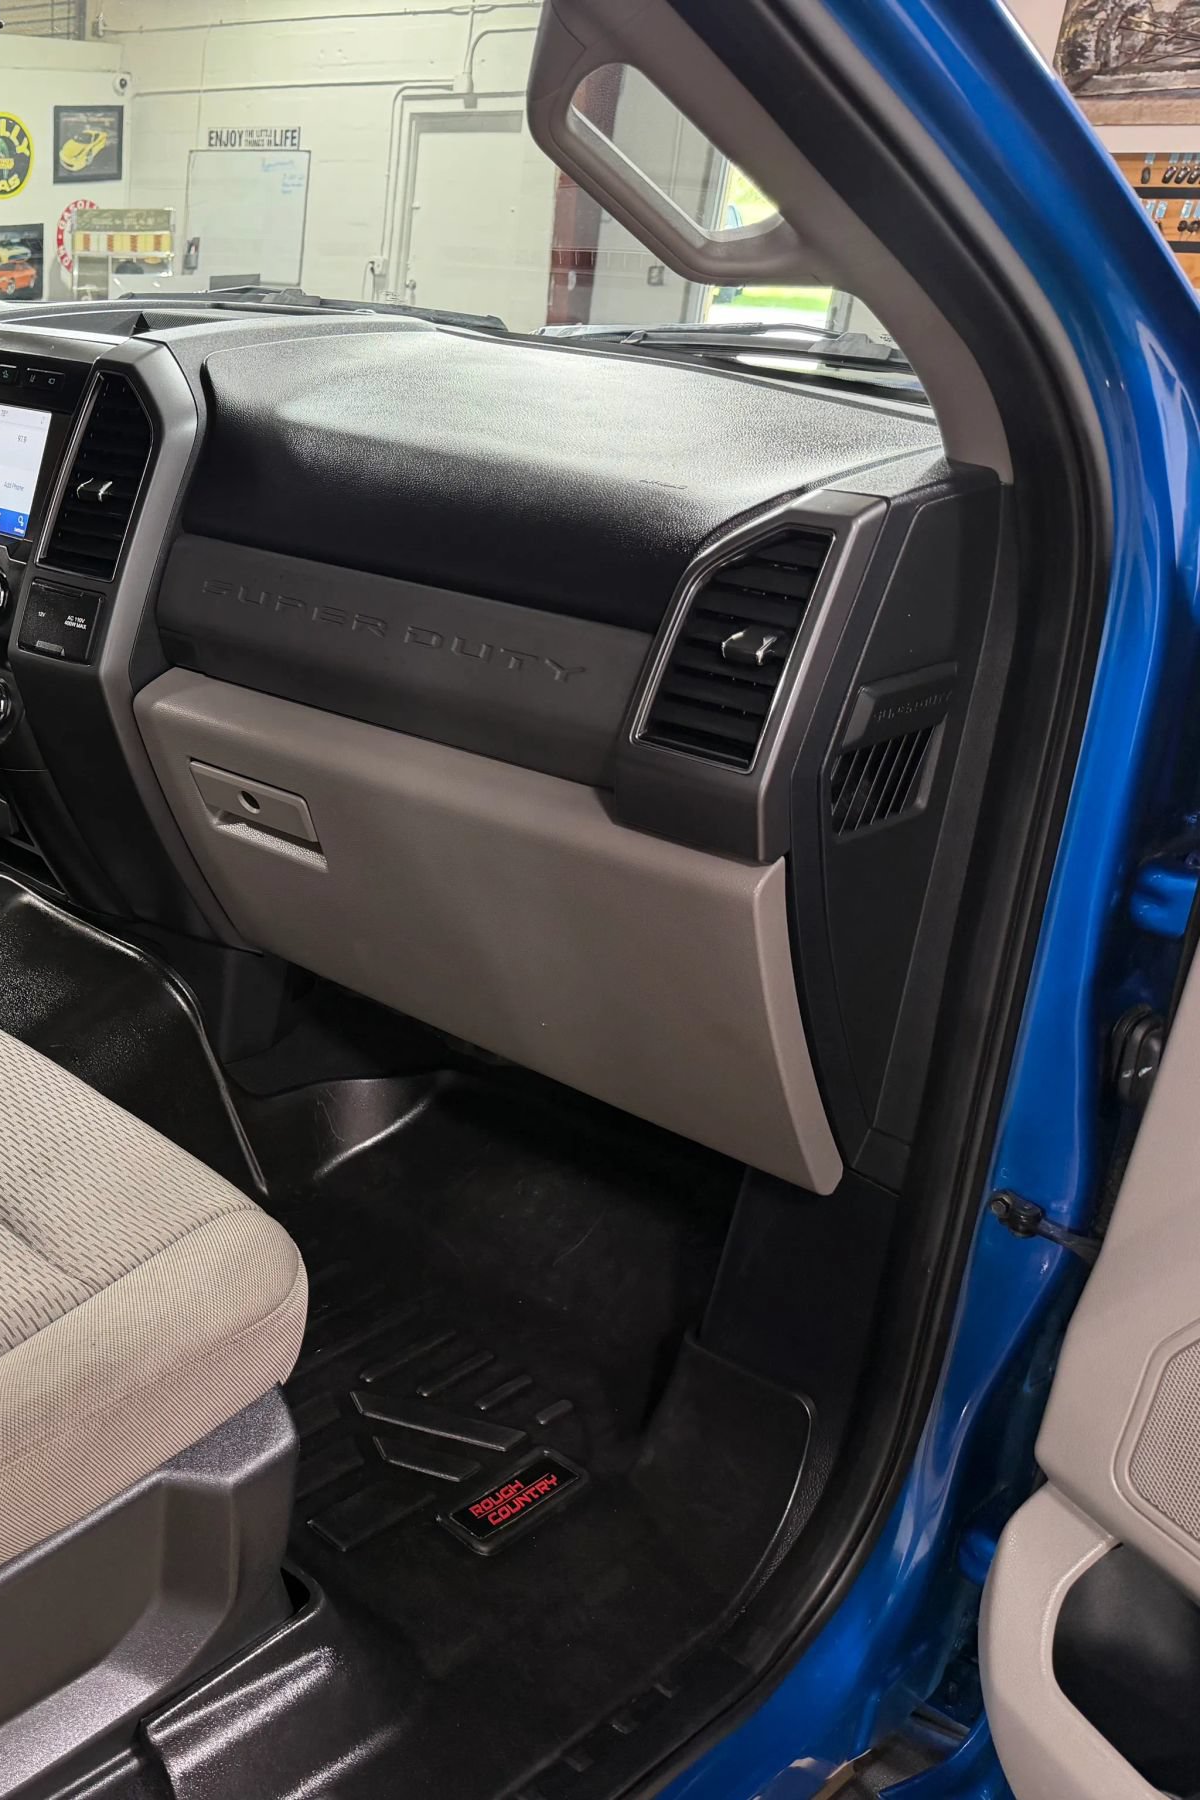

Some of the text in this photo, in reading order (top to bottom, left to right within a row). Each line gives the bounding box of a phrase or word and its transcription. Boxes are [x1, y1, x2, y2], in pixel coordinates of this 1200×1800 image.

[208, 130, 244, 148] ENJOY
[274, 129, 298, 147] LIFE
[202, 579, 587, 682] SUPER DUTY
[468, 1479, 525, 1518] ROUGH
[487, 1473, 559, 1526] COUNTRY
